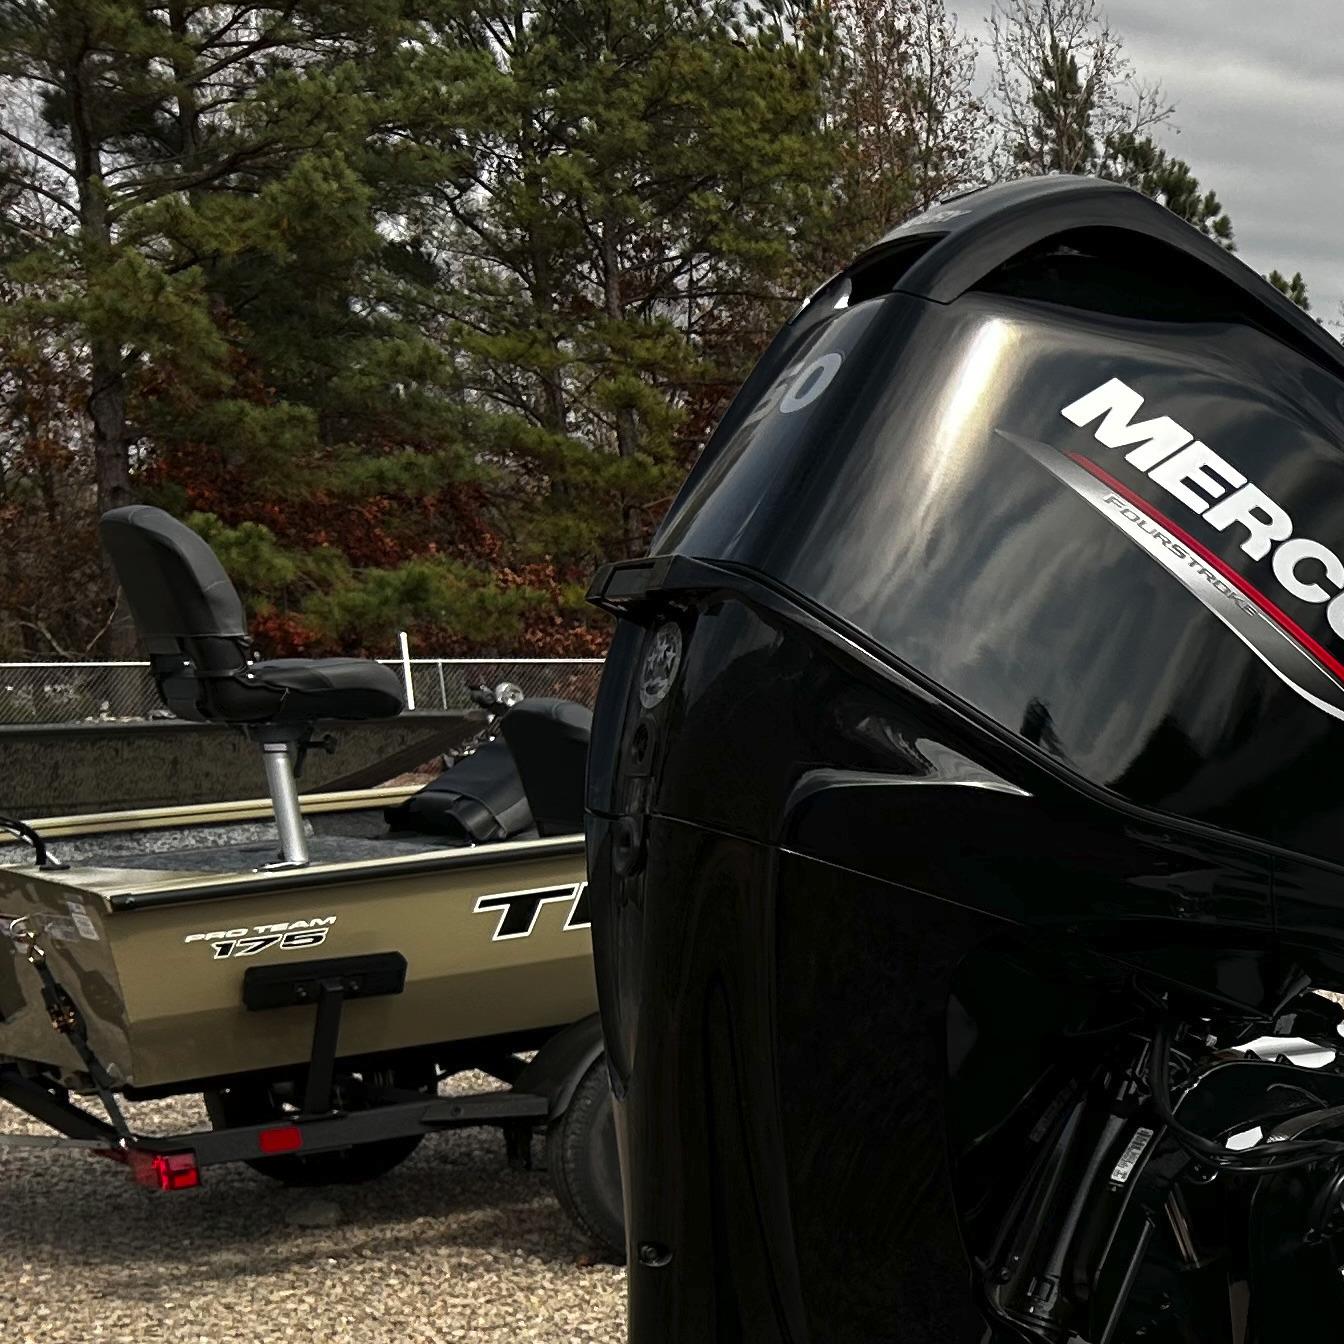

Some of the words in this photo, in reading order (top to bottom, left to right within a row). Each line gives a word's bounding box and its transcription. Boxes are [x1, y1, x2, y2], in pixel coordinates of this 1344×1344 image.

[1102, 492, 1259, 618] FOURSTROKE
[184, 928, 249, 943] PRO
[253, 915, 337, 934] TEAM
[210, 927, 329, 960] 175
